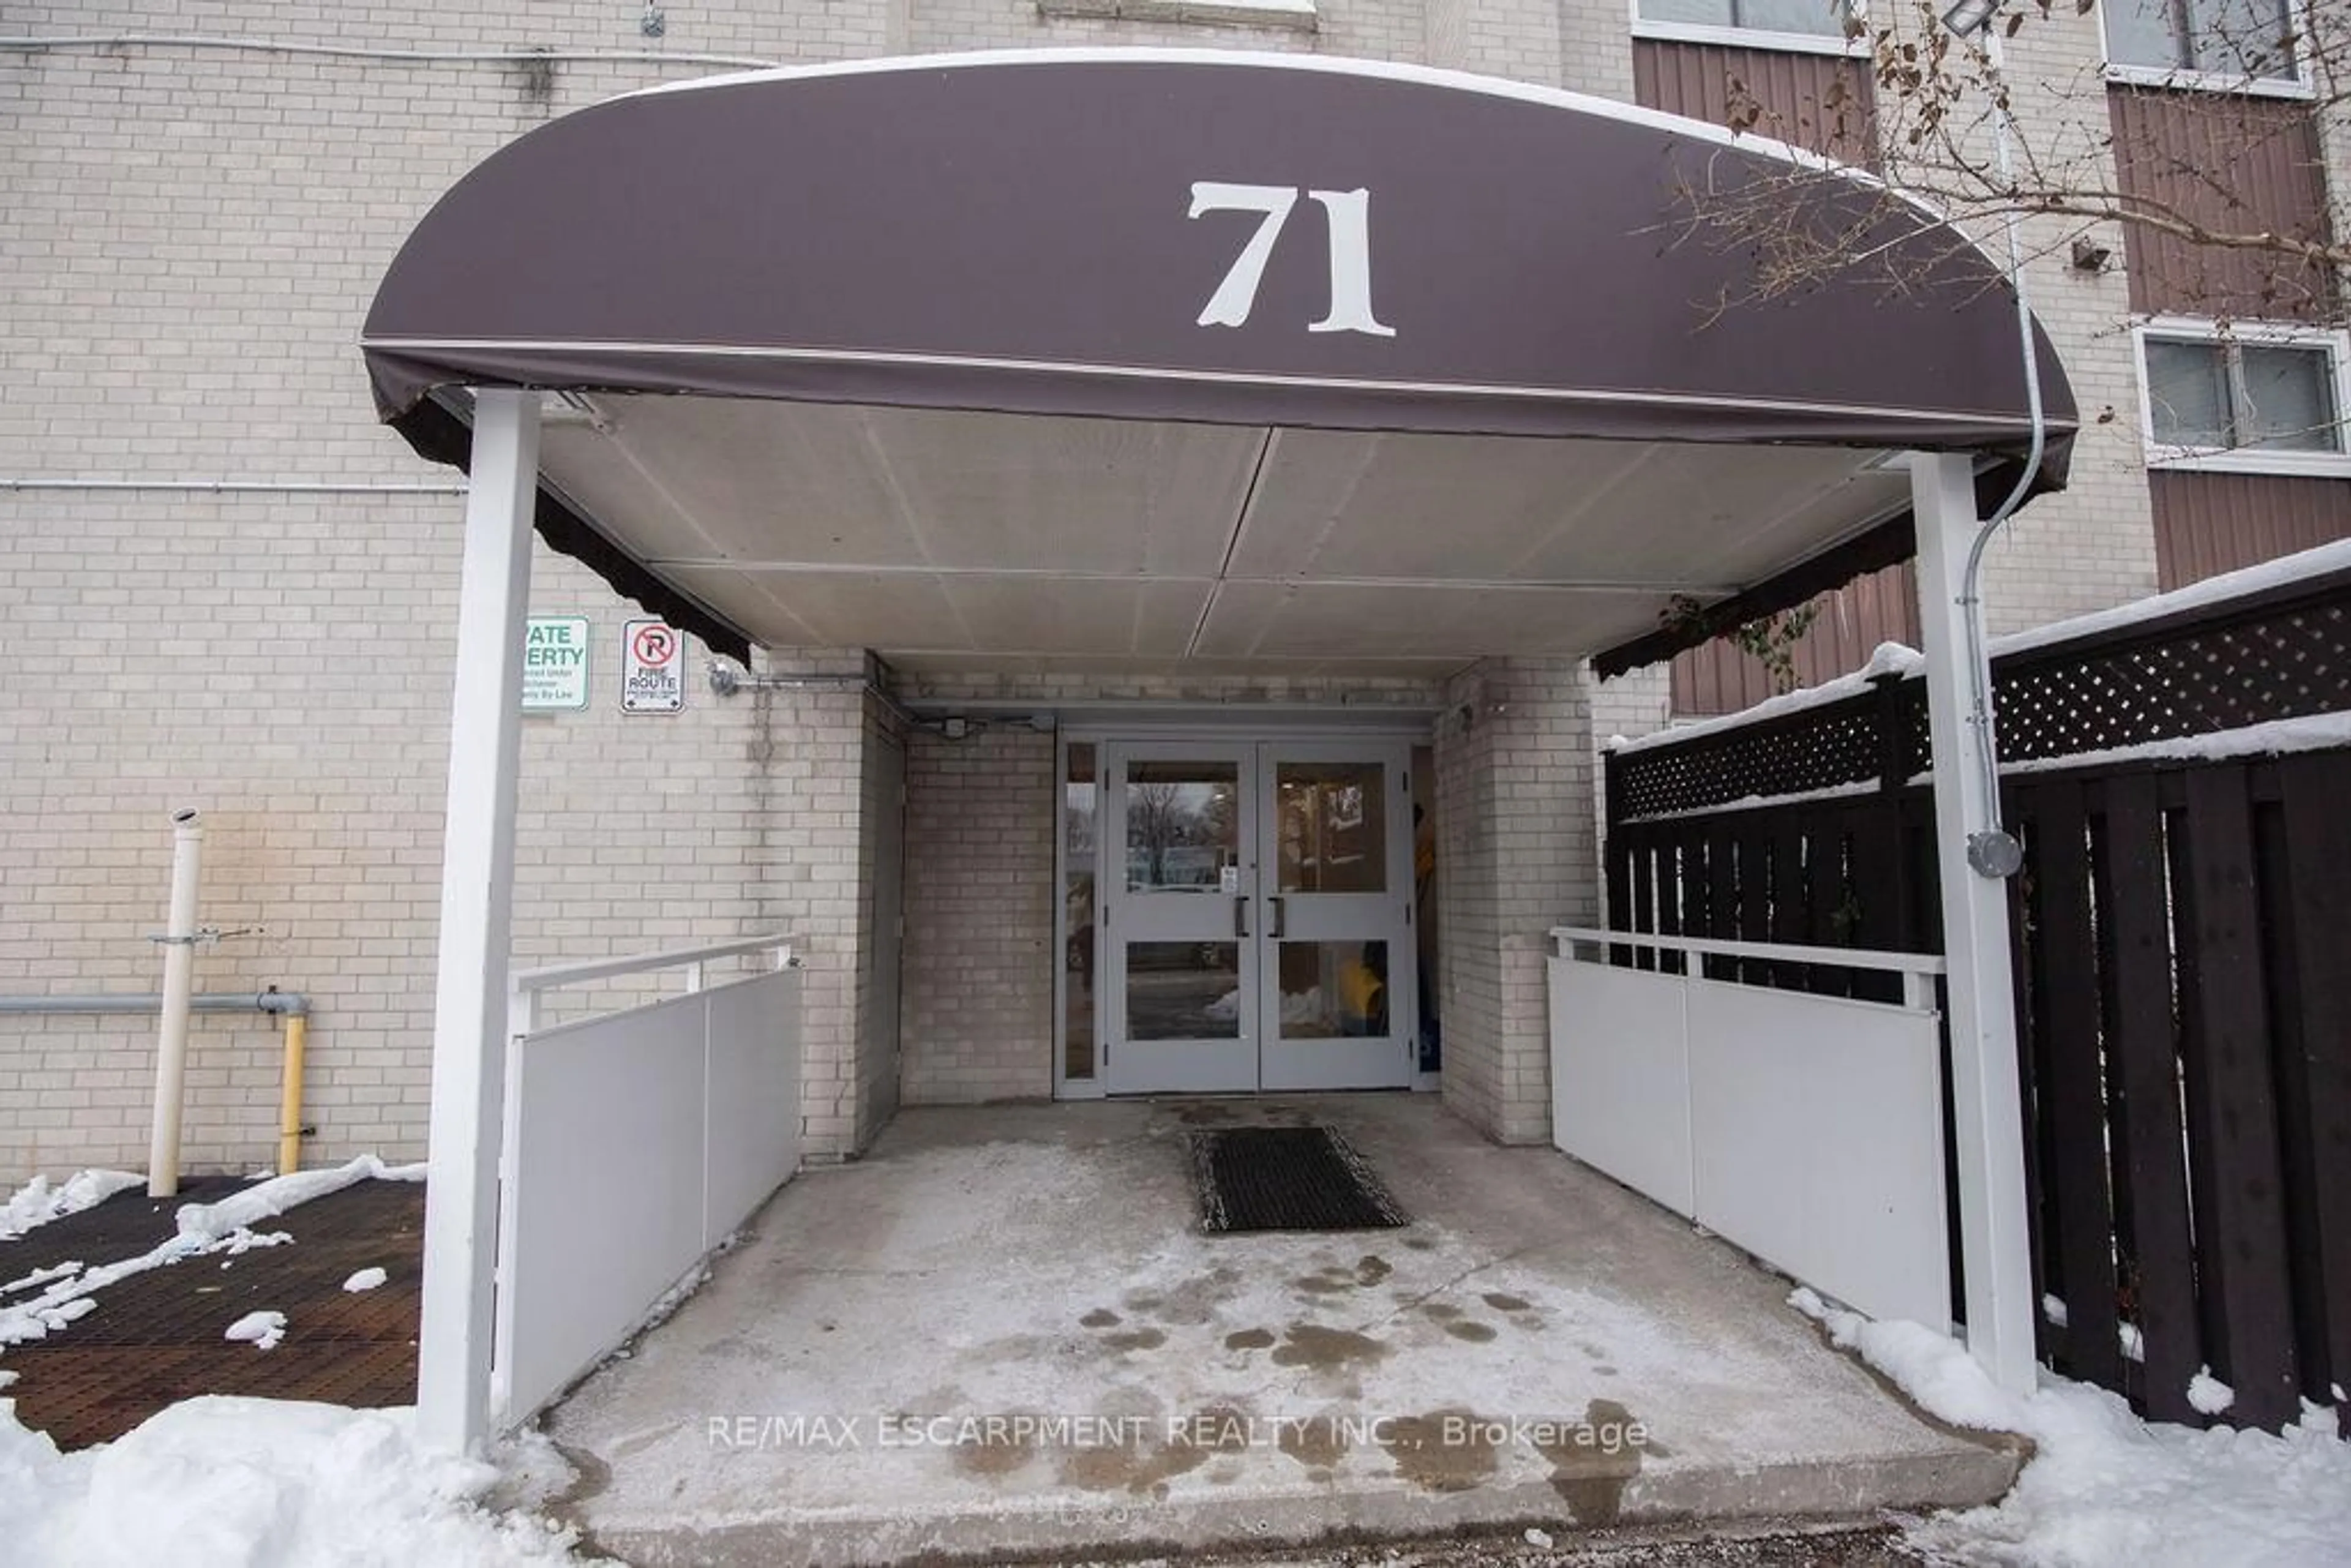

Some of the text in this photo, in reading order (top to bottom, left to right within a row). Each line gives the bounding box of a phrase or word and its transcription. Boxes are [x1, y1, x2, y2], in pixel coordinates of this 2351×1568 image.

[1188, 181, 1397, 336] 71
[647, 636, 665, 657] P
[629, 677, 677, 689] ROUTE
